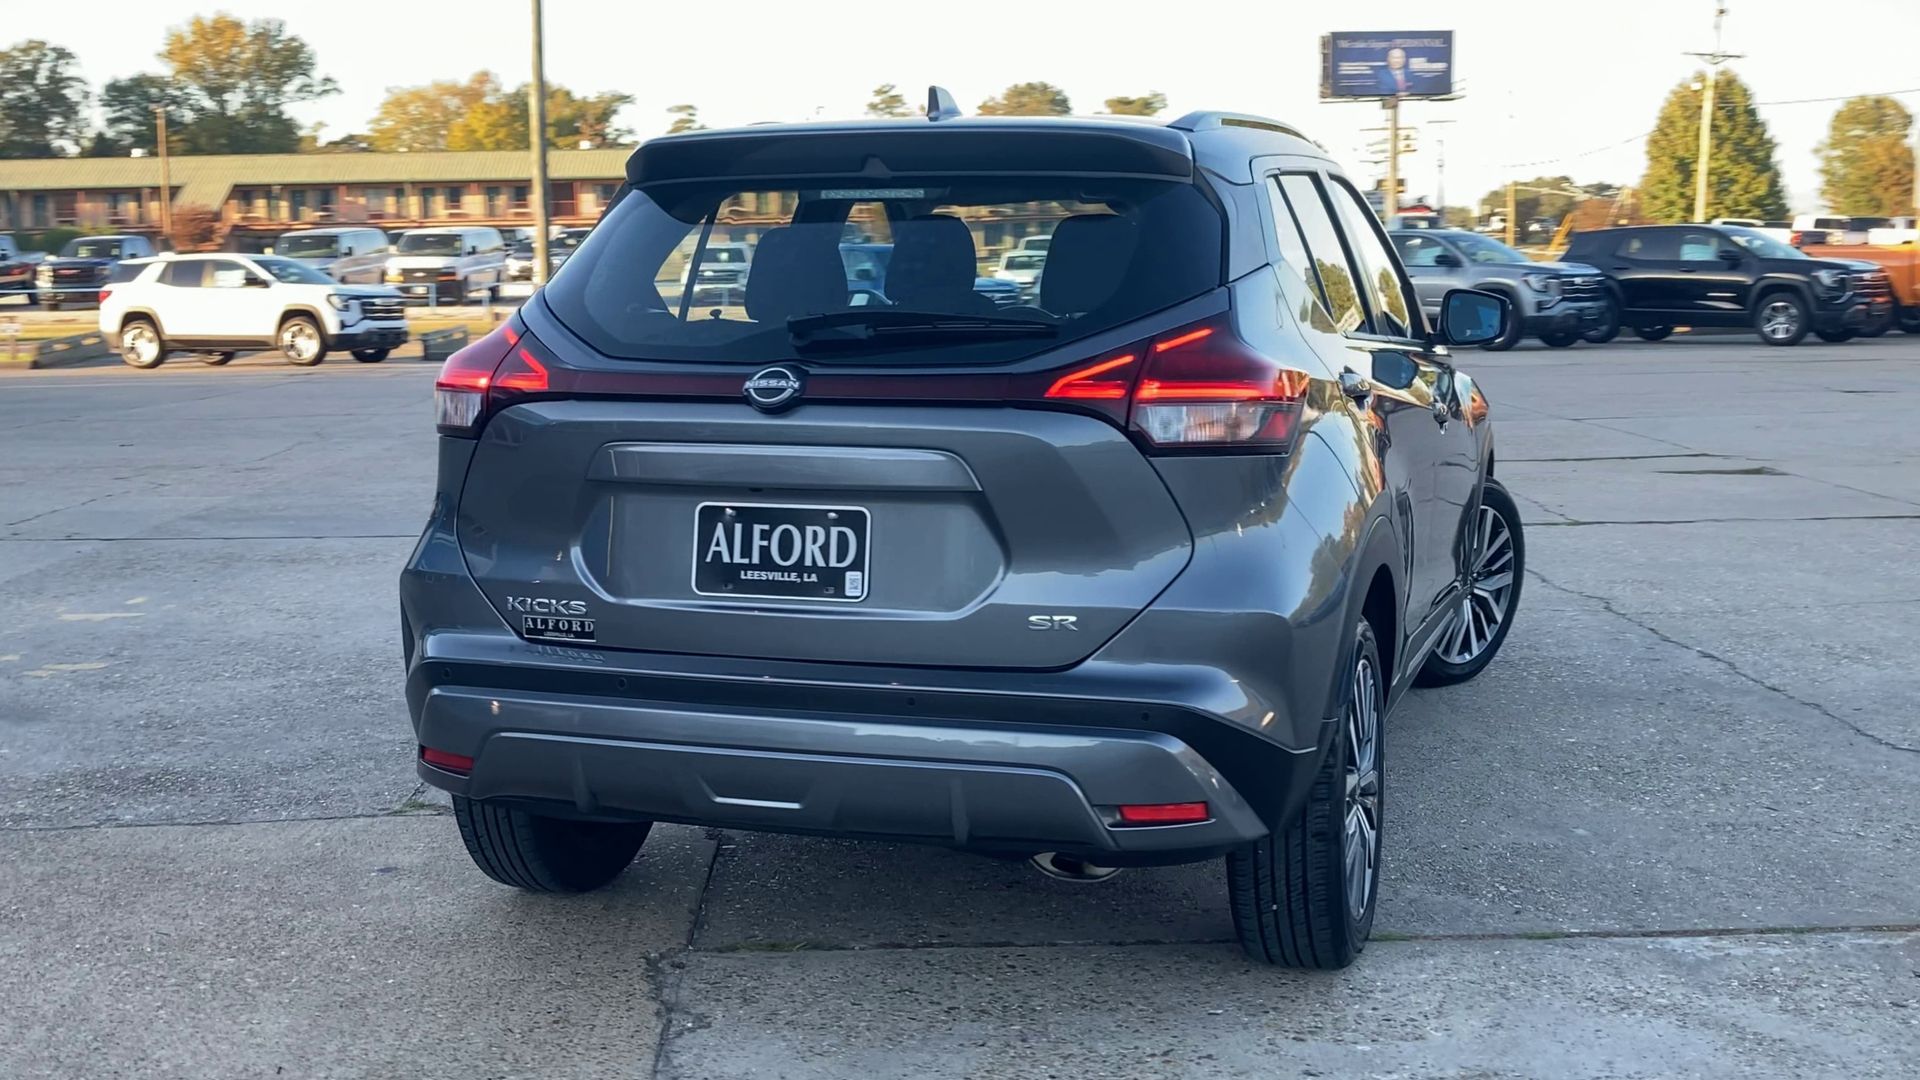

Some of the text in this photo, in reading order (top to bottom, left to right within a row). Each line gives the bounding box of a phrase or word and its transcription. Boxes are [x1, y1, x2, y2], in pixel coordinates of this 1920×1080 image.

[744, 378, 800, 389] NISSAN
[705, 522, 857, 568] ALFORD
[740, 570, 818, 583] LEESVILLE, LA
[506, 596, 587, 615] KICKS
[525, 617, 594, 632] ALFORD
[1028, 615, 1078, 631] SR
